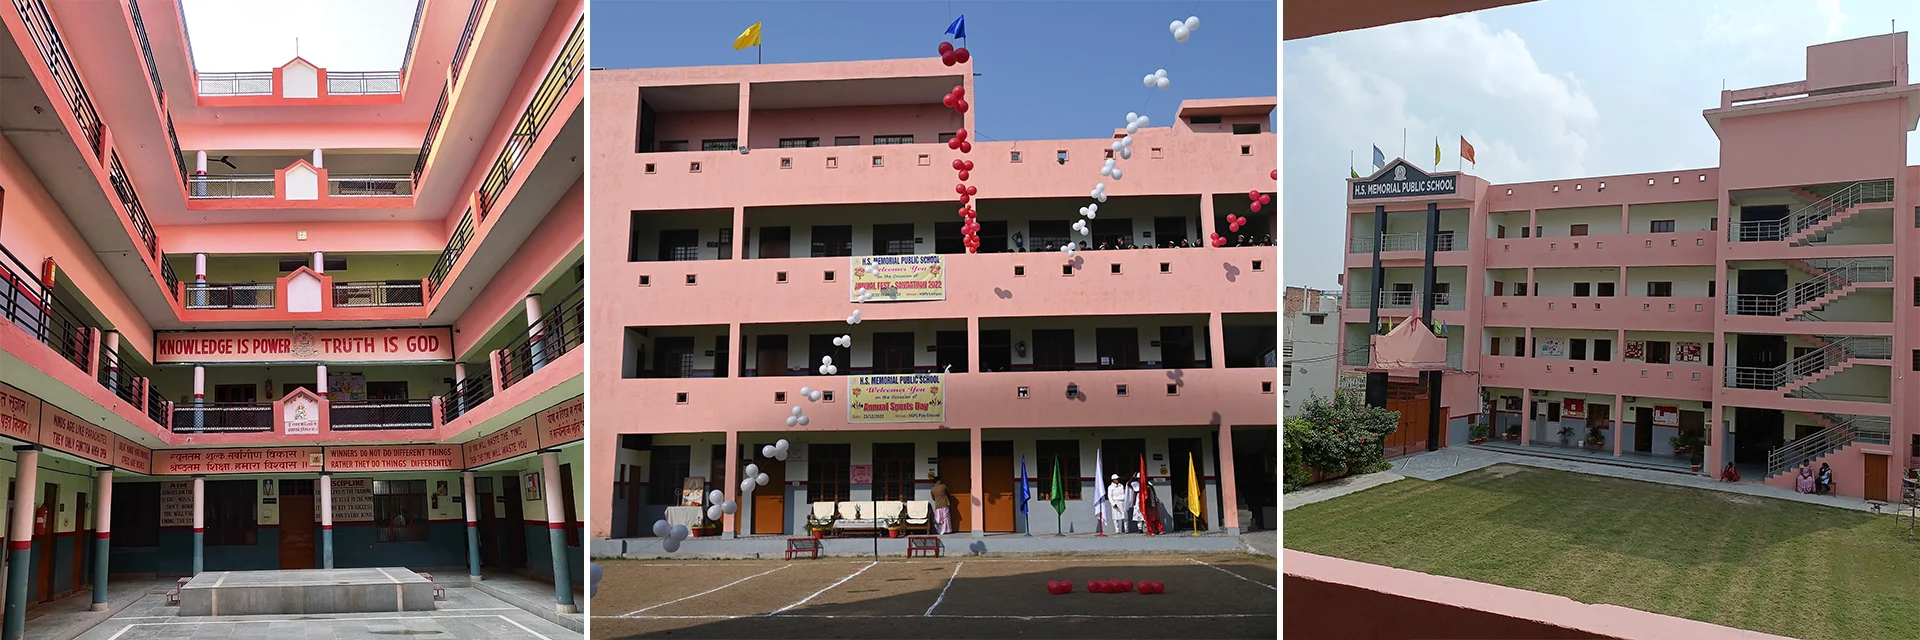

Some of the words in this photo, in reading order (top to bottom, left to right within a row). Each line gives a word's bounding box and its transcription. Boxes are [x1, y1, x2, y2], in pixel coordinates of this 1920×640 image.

[1355, 185, 1366, 195] H.S.
[1368, 183, 1400, 194] MEMORIAL
[1402, 181, 1425, 192] PUBLIC
[1427, 179, 1454, 191] SCHOOL
[874, 257, 900, 265] MEMORIAL
[901, 256, 919, 264] PUBLIC
[920, 256, 940, 264] SCHOOL
[878, 281, 891, 290] FEST
[928, 280, 942, 288] 2022
[160, 338, 232, 355] KNOWLEDGE
[238, 338, 249, 354] IS
[253, 338, 291, 354] POWER
[321, 337, 375, 354] TRUTH
[384, 336, 399, 352] IS
[406, 335, 439, 353] GOD
[860, 377, 870, 385] H.S.
[871, 376, 898, 384] MEMORIAL
[900, 376, 918, 384] PUBLIC
[919, 375, 940, 384] SCHOOL
[908, 386, 925, 394] You
[863, 402, 889, 411] Annual
[890, 402, 914, 412] Sports
[915, 402, 929, 411] Day
[67, 420, 75, 432] ARE
[76, 424, 84, 436] LIKE
[53, 432, 64, 446] THEY
[65, 436, 75, 449] ONLY
[360, 449, 368, 457] DO
[369, 449, 381, 457] NOT
[383, 449, 392, 457] DO
[394, 448, 425, 457] DIFFERENT
[429, 448, 451, 456] THINGS
[492, 448, 501, 457] WILL
[501, 443, 516, 454] WASTE
[517, 439, 527, 450] YOU
[170, 452, 200, 461] न्यूनतम
[266, 449, 296, 459] विकास
[235, 462, 260, 471] हमारा
[264, 460, 296, 470] विश्वास
[331, 460, 353, 468] RATHER
[355, 460, 370, 468] THEY
[372, 460, 380, 468] DO
[382, 460, 406, 468] THINGS
[411, 459, 452, 467] DIFFERENTLY
